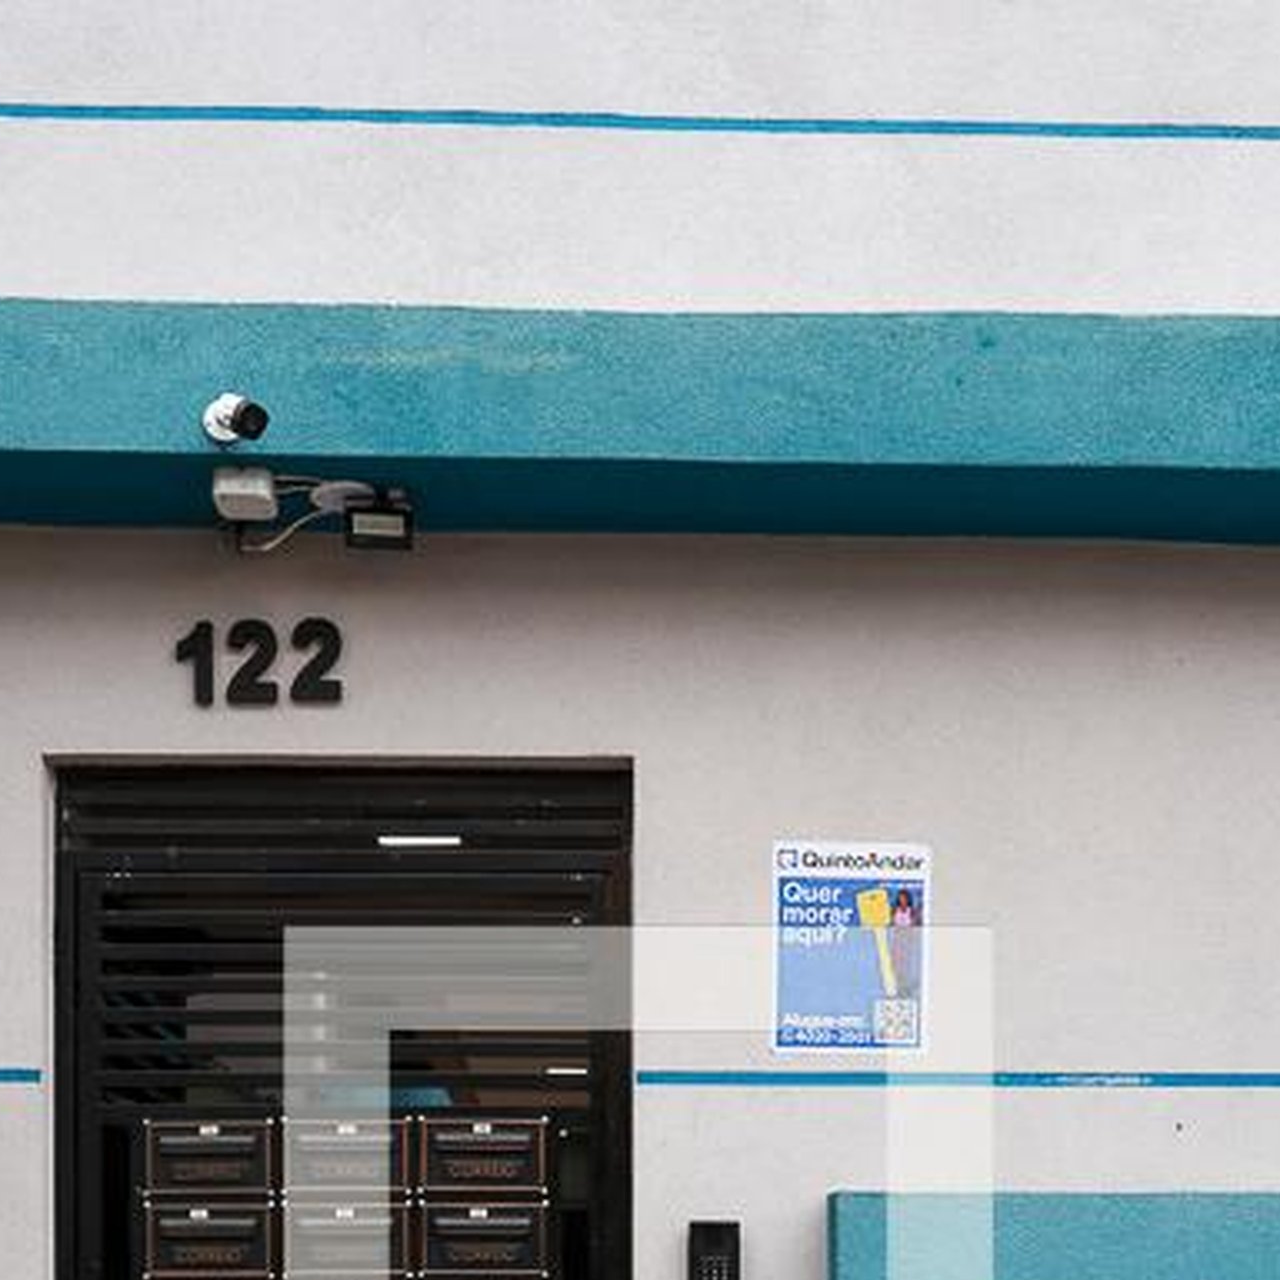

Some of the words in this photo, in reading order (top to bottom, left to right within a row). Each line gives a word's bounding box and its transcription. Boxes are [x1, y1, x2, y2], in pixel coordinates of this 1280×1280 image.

[175, 617, 344, 710] 122
[782, 881, 843, 904] Quer
[782, 906, 854, 924] morar
[782, 923, 848, 947] aqui?
